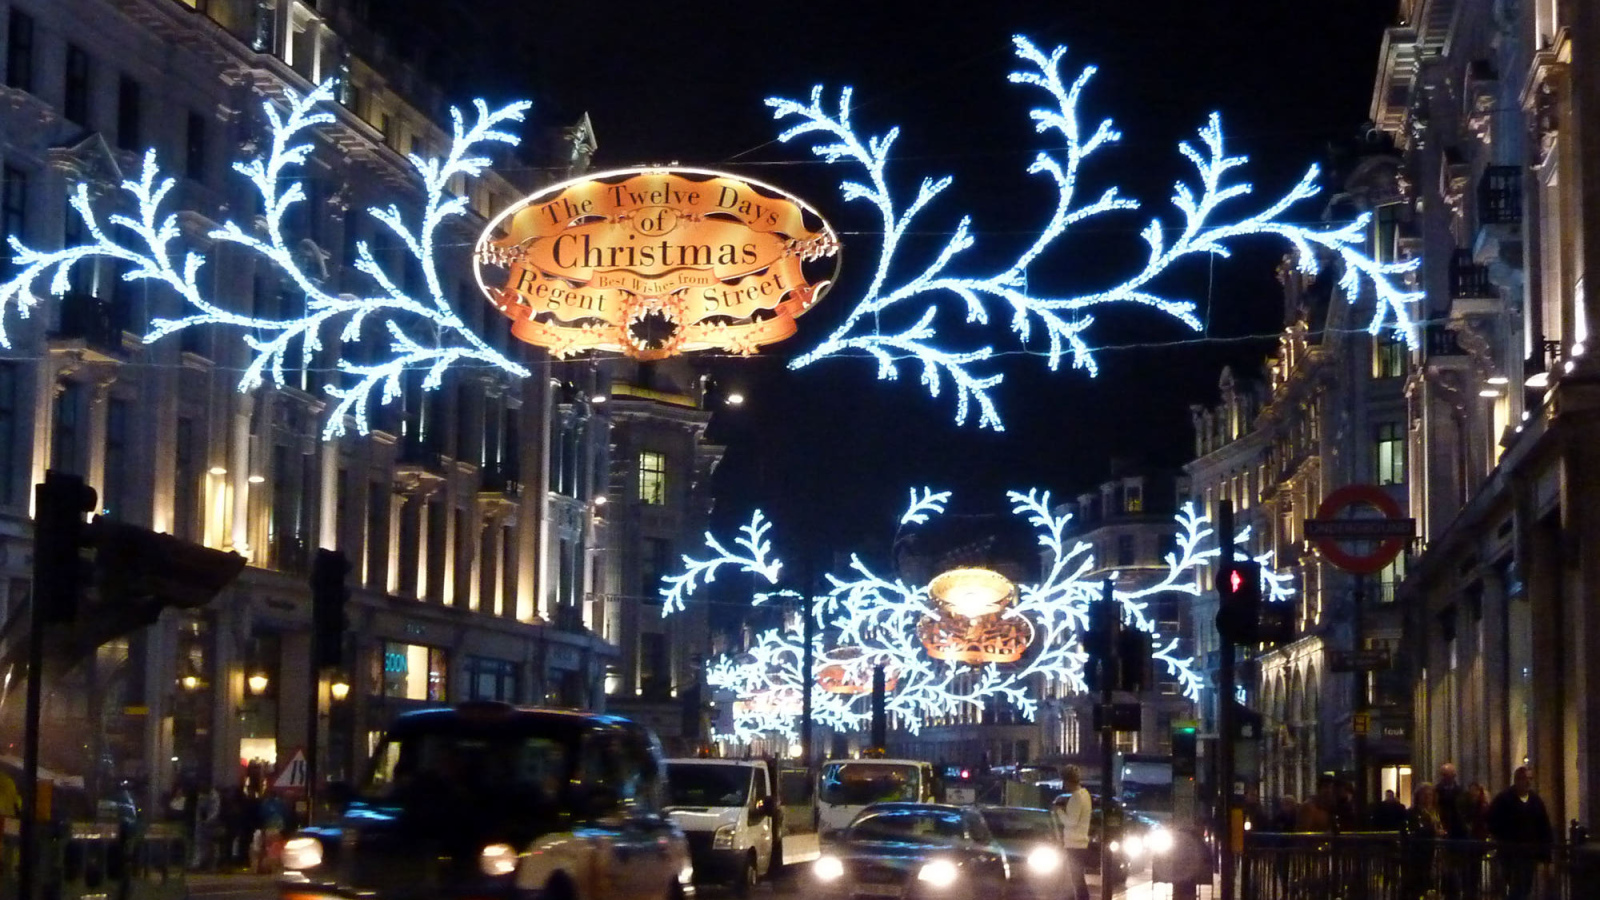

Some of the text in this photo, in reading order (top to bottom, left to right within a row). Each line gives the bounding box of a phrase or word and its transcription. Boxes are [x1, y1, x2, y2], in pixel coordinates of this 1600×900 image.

[542, 183, 780, 227] The Twelve Days
[641, 209, 669, 232] of
[552, 234, 758, 270] Christmas
[516, 269, 787, 313] Regent Street
[598, 272, 709, 293] Best Wishes from
[1309, 522, 1412, 535] UNDERGROUND
